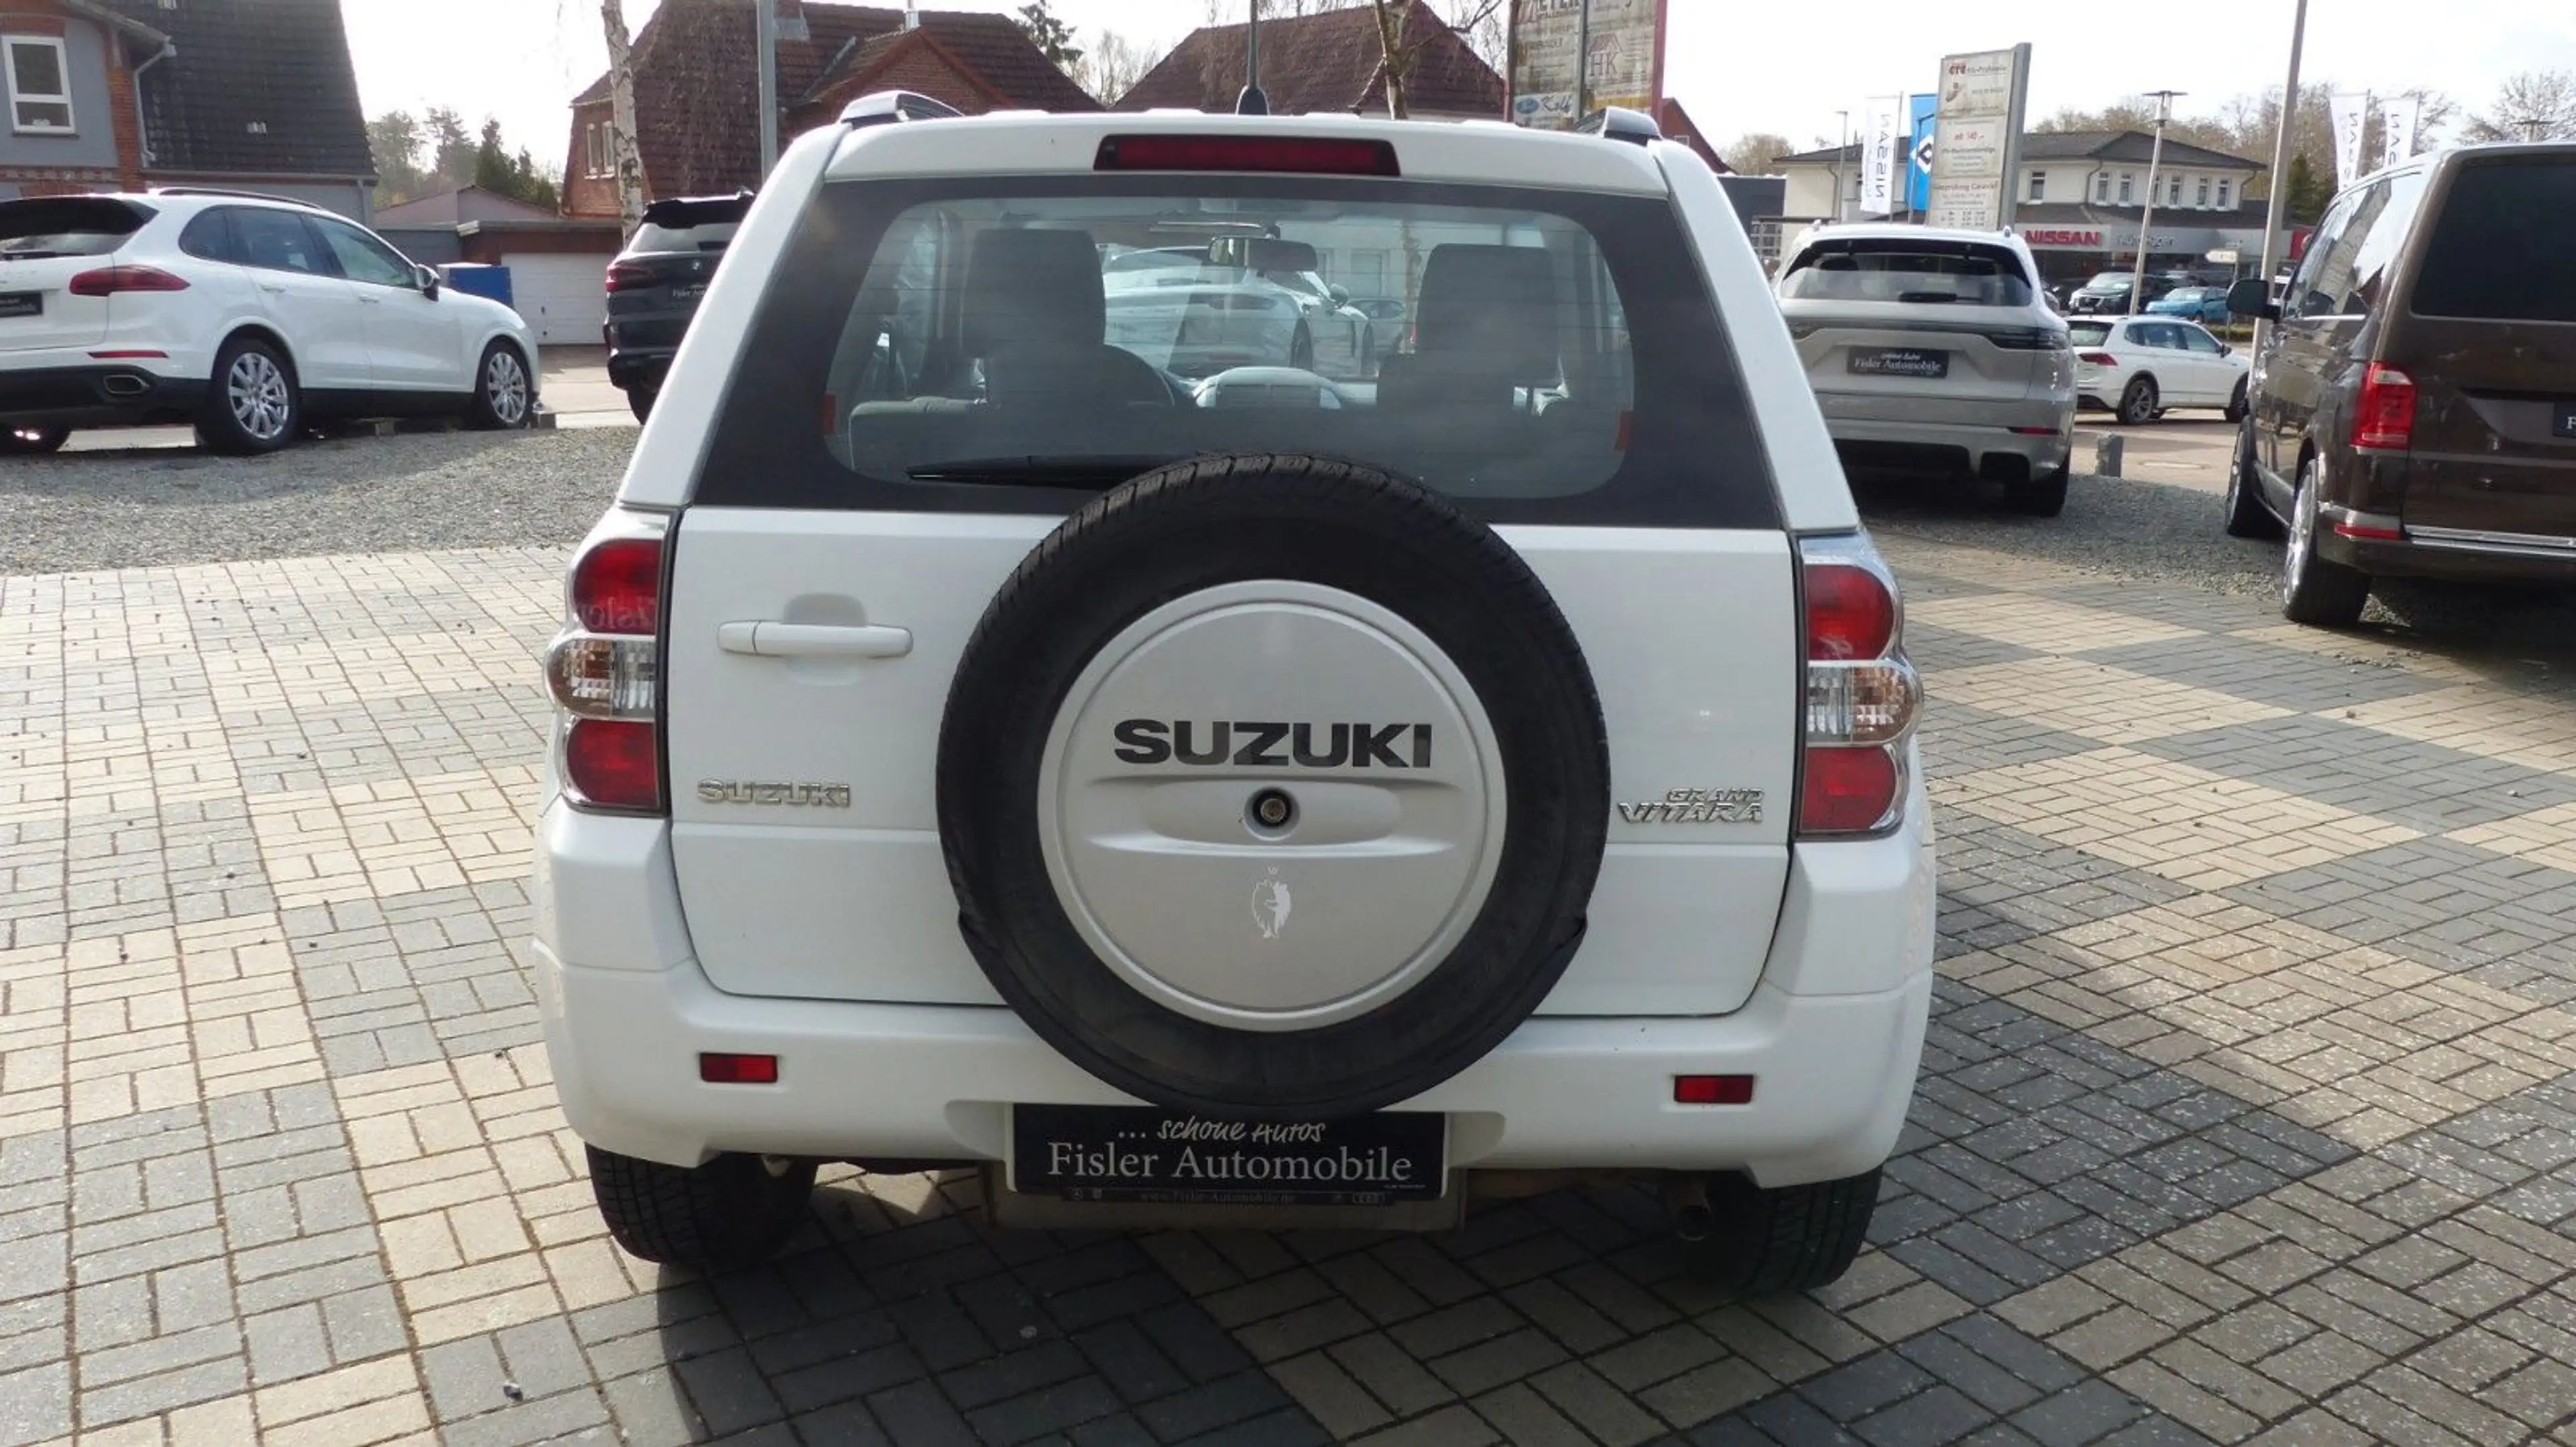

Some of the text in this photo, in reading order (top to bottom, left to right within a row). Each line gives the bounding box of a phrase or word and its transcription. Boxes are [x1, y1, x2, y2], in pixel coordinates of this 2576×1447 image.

[2025, 230, 2102, 246] NISSAN
[1114, 719, 1432, 769] SUZUKI
[697, 778, 850, 807] SUZUKI
[1668, 788, 1764, 802] GRAND
[1618, 802, 1764, 823] VITARA
[1252, 1122, 1326, 1144] Autos
[1047, 1142, 1411, 1181] Fisler Automobile
